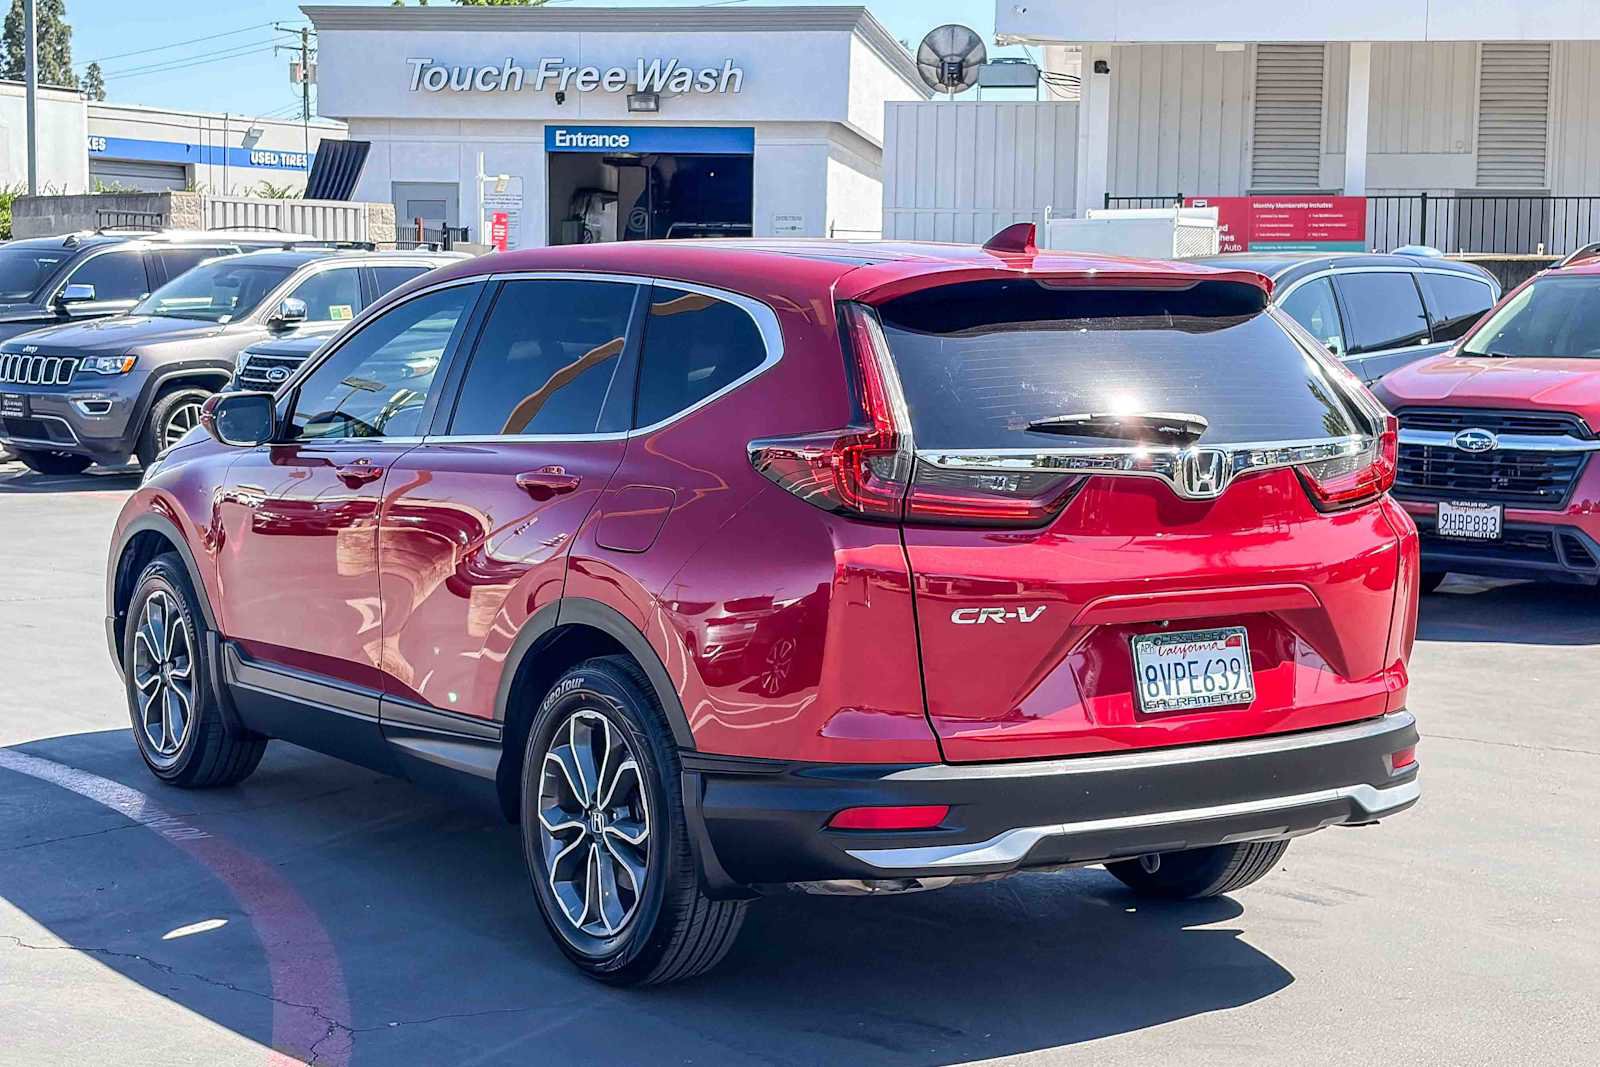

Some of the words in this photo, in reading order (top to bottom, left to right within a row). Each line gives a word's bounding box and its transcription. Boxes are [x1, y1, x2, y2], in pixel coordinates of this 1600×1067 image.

[405, 57, 524, 93] Touch
[535, 57, 628, 93] Free
[636, 57, 745, 94] Wash
[555, 130, 630, 149] Entrance
[250, 151, 279, 166] USED
[280, 153, 308, 169] TIRES
[1224, 243, 1242, 251] Auto
[1441, 513, 1497, 533] 9HBP883
[951, 605, 1047, 624] CR-V
[1158, 642, 1227, 660] California
[1145, 658, 1242, 698] 8VPE639
[1145, 690, 1252, 710] SACRAMENTO
